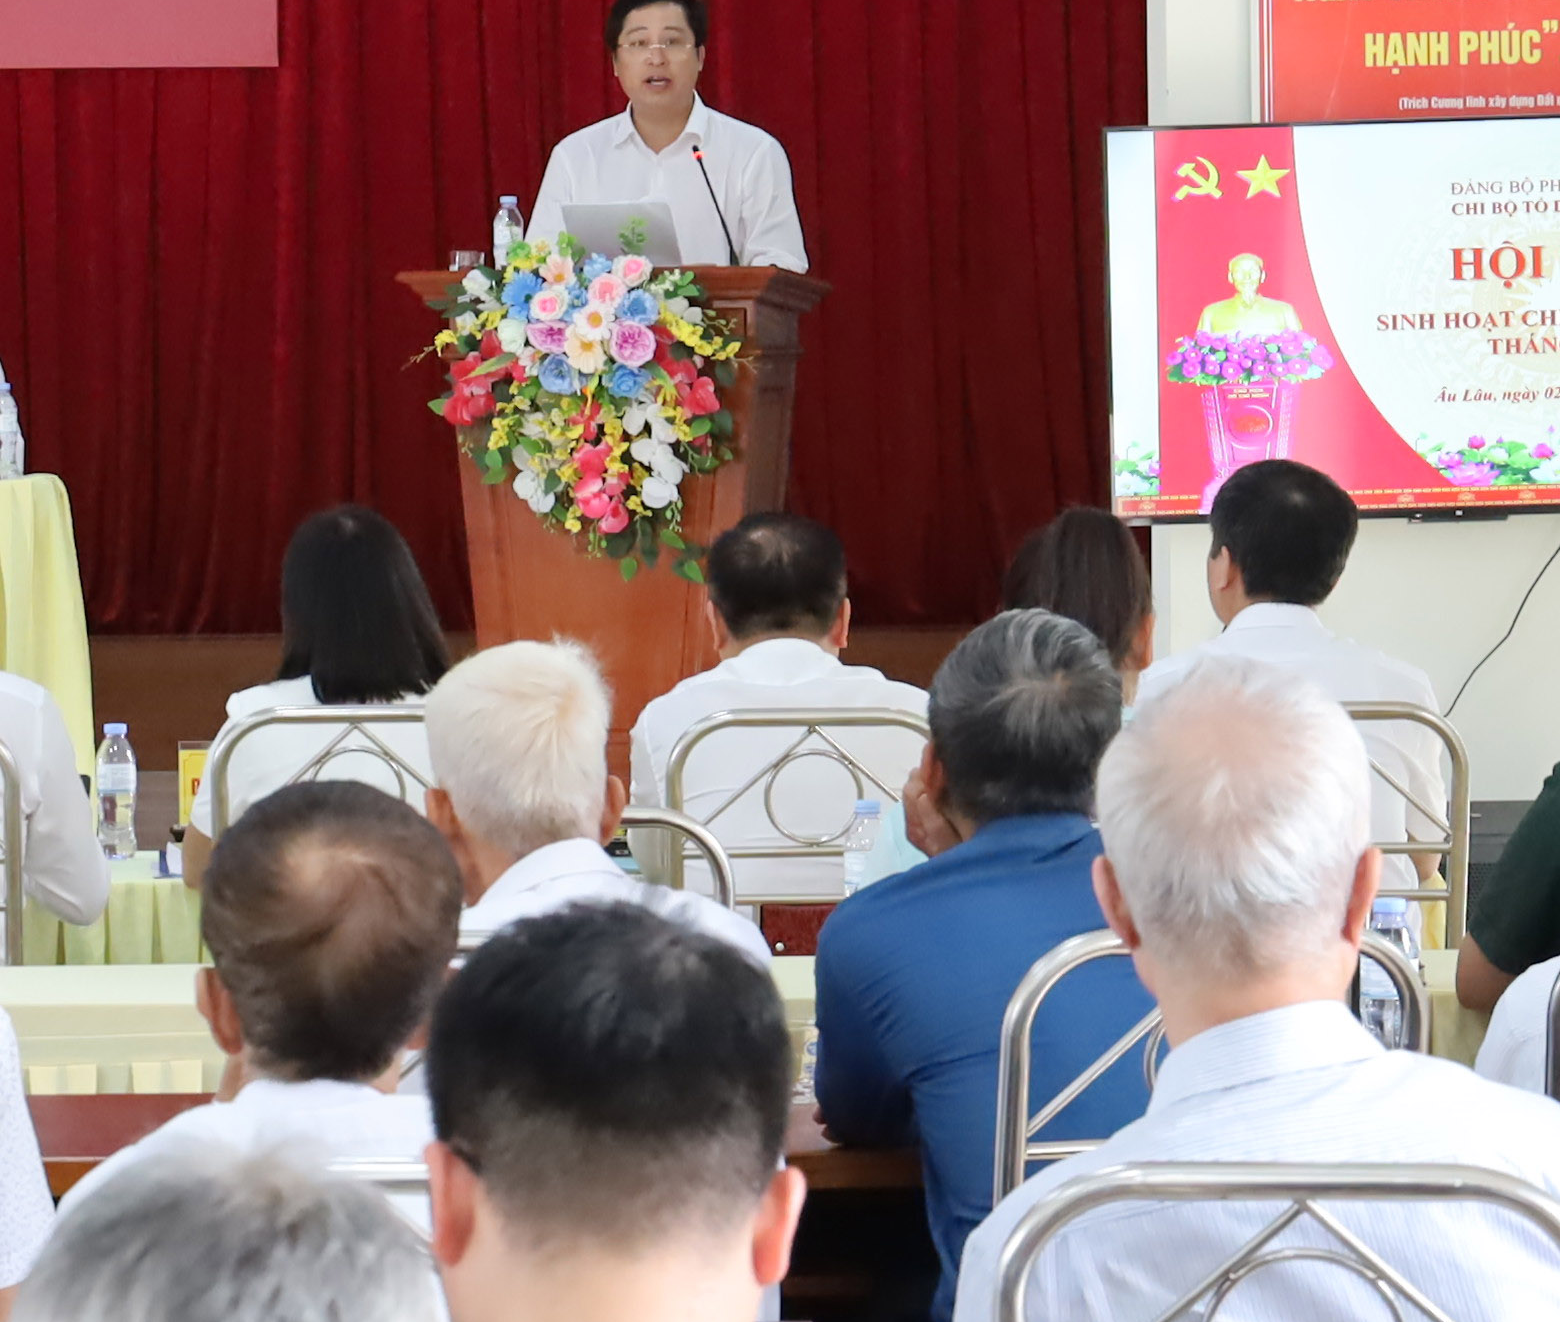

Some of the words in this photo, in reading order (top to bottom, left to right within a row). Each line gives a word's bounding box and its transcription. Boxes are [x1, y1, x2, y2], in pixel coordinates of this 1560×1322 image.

[1363, 32, 1450, 74] HẠNH
[1449, 240, 1545, 288] HỘI
[1377, 313, 1435, 331] SINH
[1444, 311, 1515, 331] HOẠT
